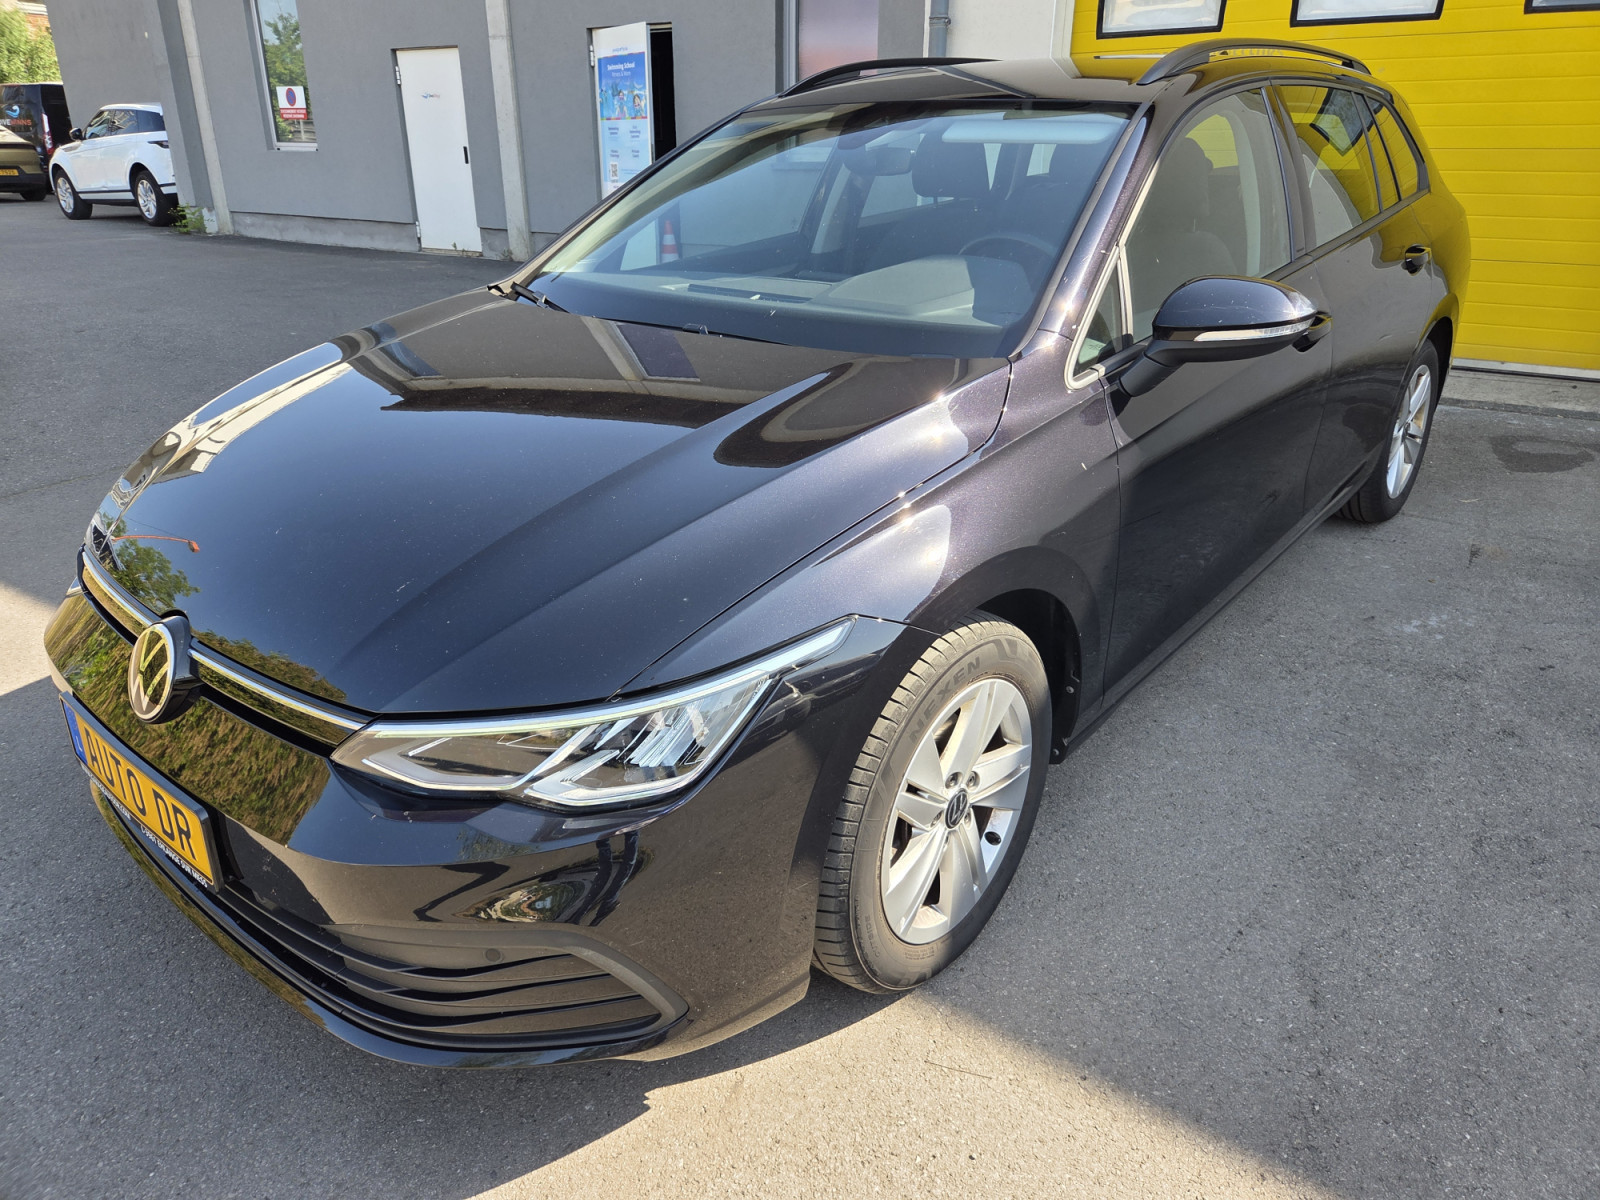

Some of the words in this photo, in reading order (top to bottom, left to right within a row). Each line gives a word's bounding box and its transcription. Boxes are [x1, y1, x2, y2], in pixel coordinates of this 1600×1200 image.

[909, 656, 981, 742] NEXEN
[84, 726, 147, 817] AUTO
[152, 787, 198, 862] DR
